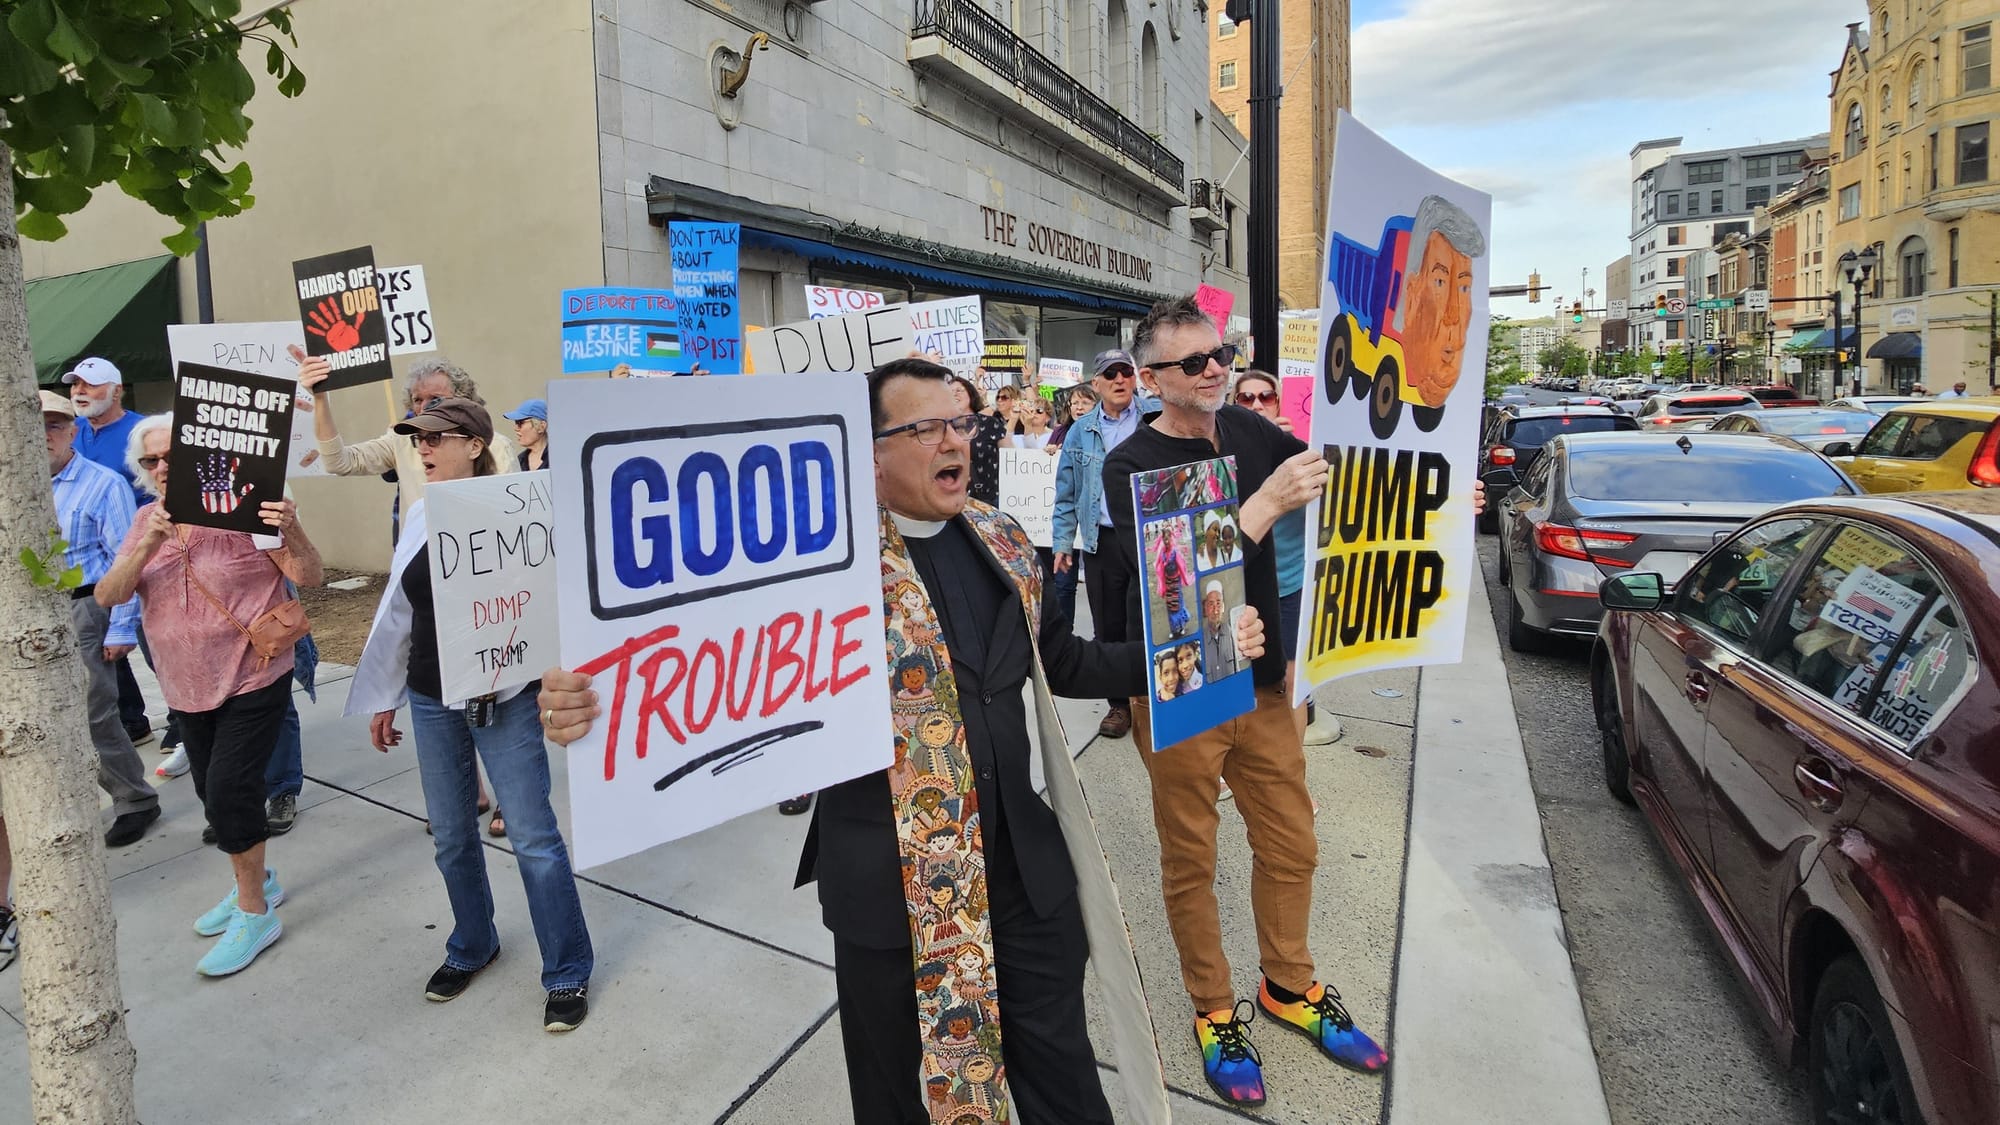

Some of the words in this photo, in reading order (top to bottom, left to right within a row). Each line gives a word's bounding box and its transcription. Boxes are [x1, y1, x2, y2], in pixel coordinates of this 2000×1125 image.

[670, 227, 705, 249] DON'T
[708, 227, 737, 248] TALK
[980, 205, 1017, 247] THE
[1028, 222, 1101, 269] SOVEREIGN
[1107, 247, 1152, 282] BUILDING
[672, 251, 712, 268] ABOUT
[298, 272, 346, 299] HANDS
[348, 265, 374, 290] OFF
[673, 269, 734, 283] PROTECTING
[342, 287, 378, 316] OUR
[704, 284, 736, 298] WHEN
[813, 287, 880, 310] STOP
[570, 295, 639, 314] DEPORT
[676, 298, 690, 317] YOU
[693, 302, 731, 317] VOTED
[936, 305, 980, 327] LIVES
[586, 326, 641, 342] FREE
[679, 317, 692, 330] FOR
[697, 318, 706, 331] A
[1289, 323, 1306, 331] OUT
[1705, 308, 1713, 339] ICHAEL
[564, 340, 641, 360] PALESTINE
[681, 330, 740, 360] RAPIST
[774, 307, 903, 374] DUE
[1008, 344, 1027, 356] FIRST
[213, 343, 274, 364] PAIN
[320, 343, 386, 371] MOCRACY
[1041, 363, 1080, 373] MEDICAID
[1286, 366, 1311, 376] THE
[180, 376, 250, 407] HANDS
[254, 389, 290, 413] OFF
[196, 403, 269, 433] SOCIAL
[181, 424, 280, 458] SECURITY
[1007, 495, 1036, 507] our
[1317, 443, 1451, 549] DUMP
[610, 441, 838, 589] GOOD
[474, 590, 531, 629] DUMP
[1307, 549, 1444, 663] TRUMP
[475, 640, 529, 673] TRUMP
[573, 604, 872, 782] TROUBLE
